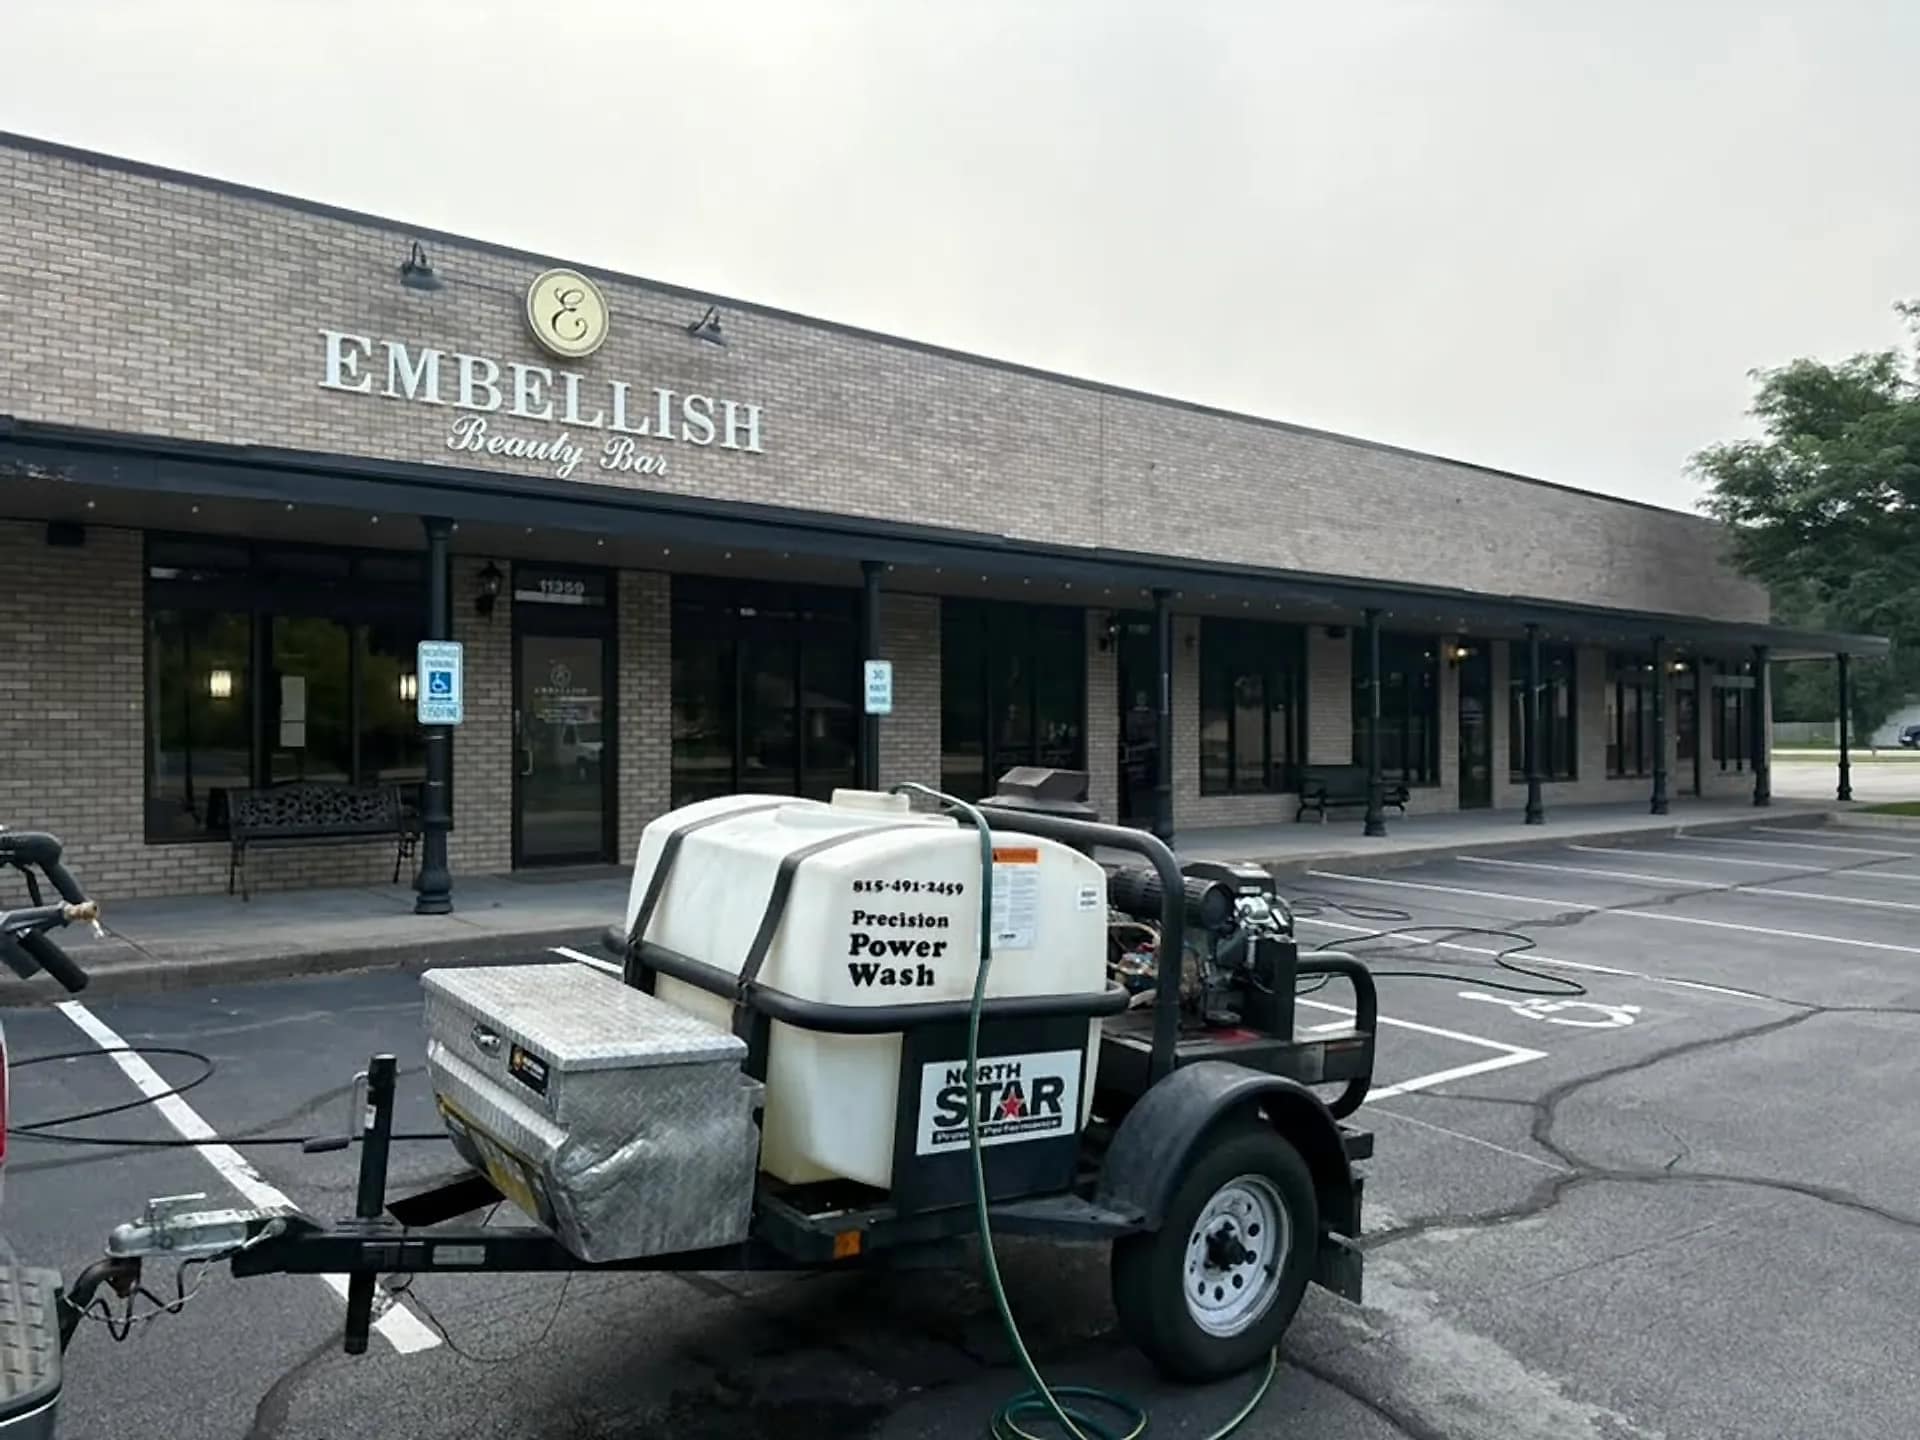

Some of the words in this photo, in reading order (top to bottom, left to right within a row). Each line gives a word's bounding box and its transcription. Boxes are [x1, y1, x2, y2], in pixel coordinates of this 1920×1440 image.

[319, 329, 766, 454] EMBELLISH
[446, 414, 584, 479] Beauty
[600, 435, 670, 477] Bar
[852, 910, 949, 928] Precision
[848, 933, 948, 958] Power
[848, 963, 936, 987] Wash
[933, 1076, 1066, 1128] STAR
